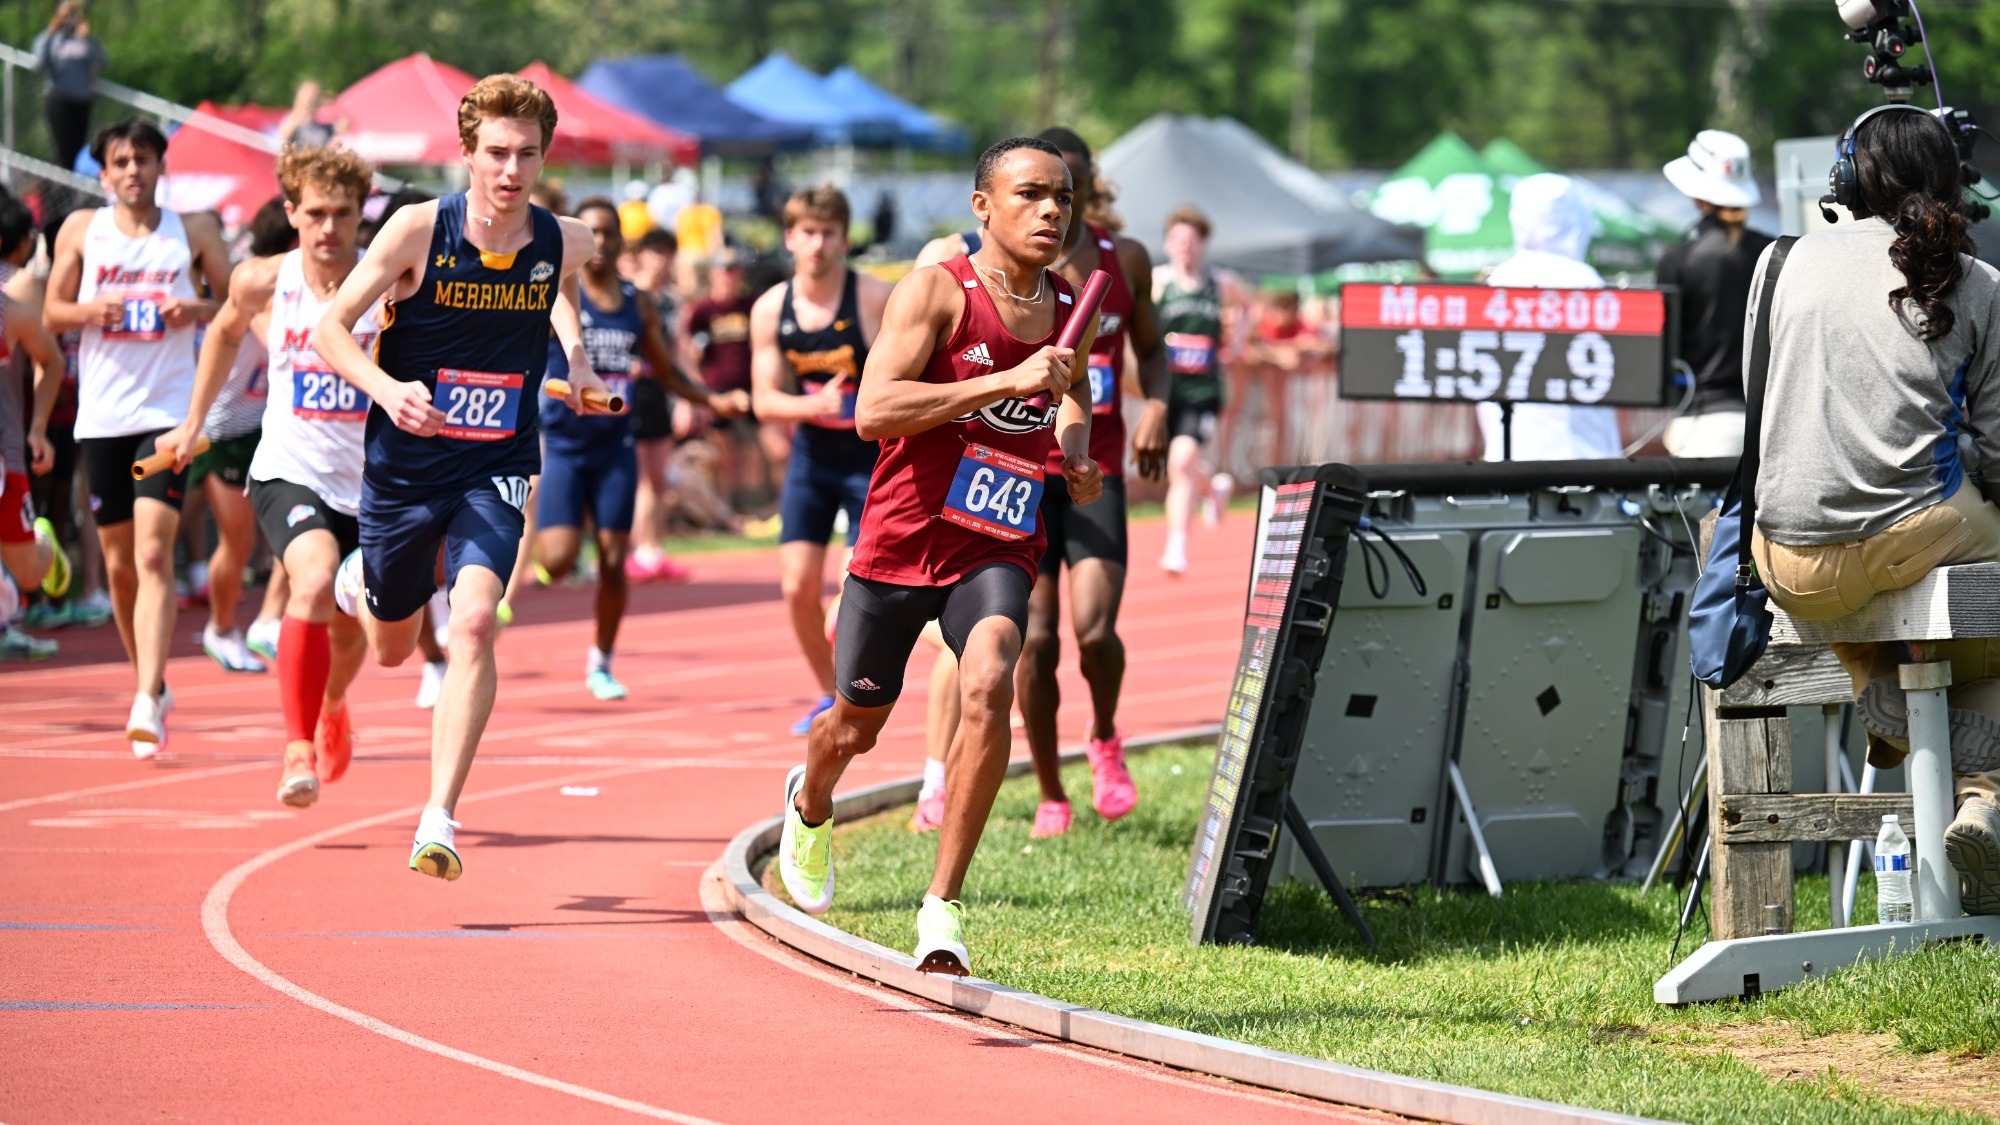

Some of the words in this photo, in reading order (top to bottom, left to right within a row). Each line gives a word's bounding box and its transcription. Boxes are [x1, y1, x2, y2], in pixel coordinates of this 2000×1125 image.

[434, 280, 550, 310] MERRIMACK
[1379, 285, 1467, 326] Men
[1483, 288, 1621, 331] 4x800
[112, 299, 156, 333] 13
[962, 353, 994, 366] adidas
[1393, 328, 1615, 405] 1:57.9
[302, 372, 356, 411] 236
[445, 386, 506, 428] 282
[965, 467, 1032, 525] 643
